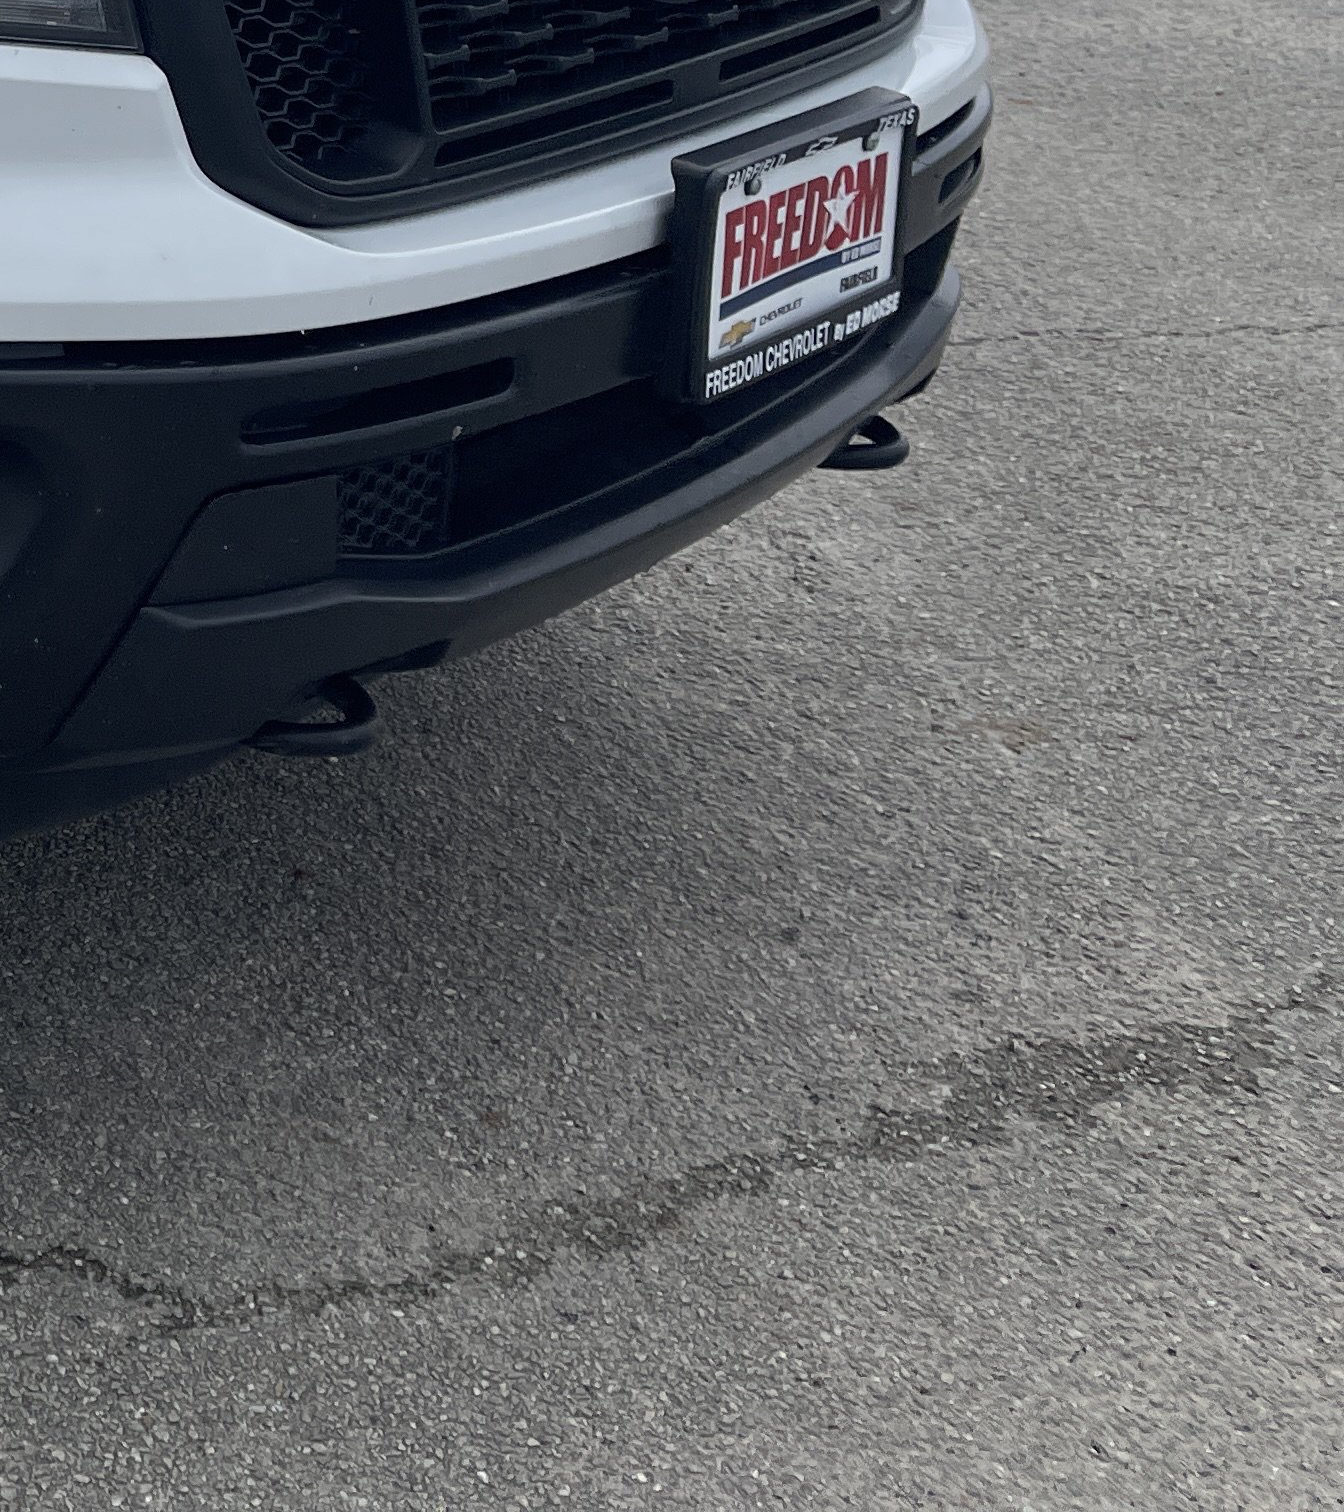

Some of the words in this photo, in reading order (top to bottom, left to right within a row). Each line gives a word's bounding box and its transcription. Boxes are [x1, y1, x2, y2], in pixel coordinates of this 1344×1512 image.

[721, 152, 889, 300] FREEDOM
[705, 351, 764, 398] FREEDOM
[765, 321, 831, 372] CHEVROLET
[845, 310, 861, 335] ED
[861, 291, 901, 328] MORSE
